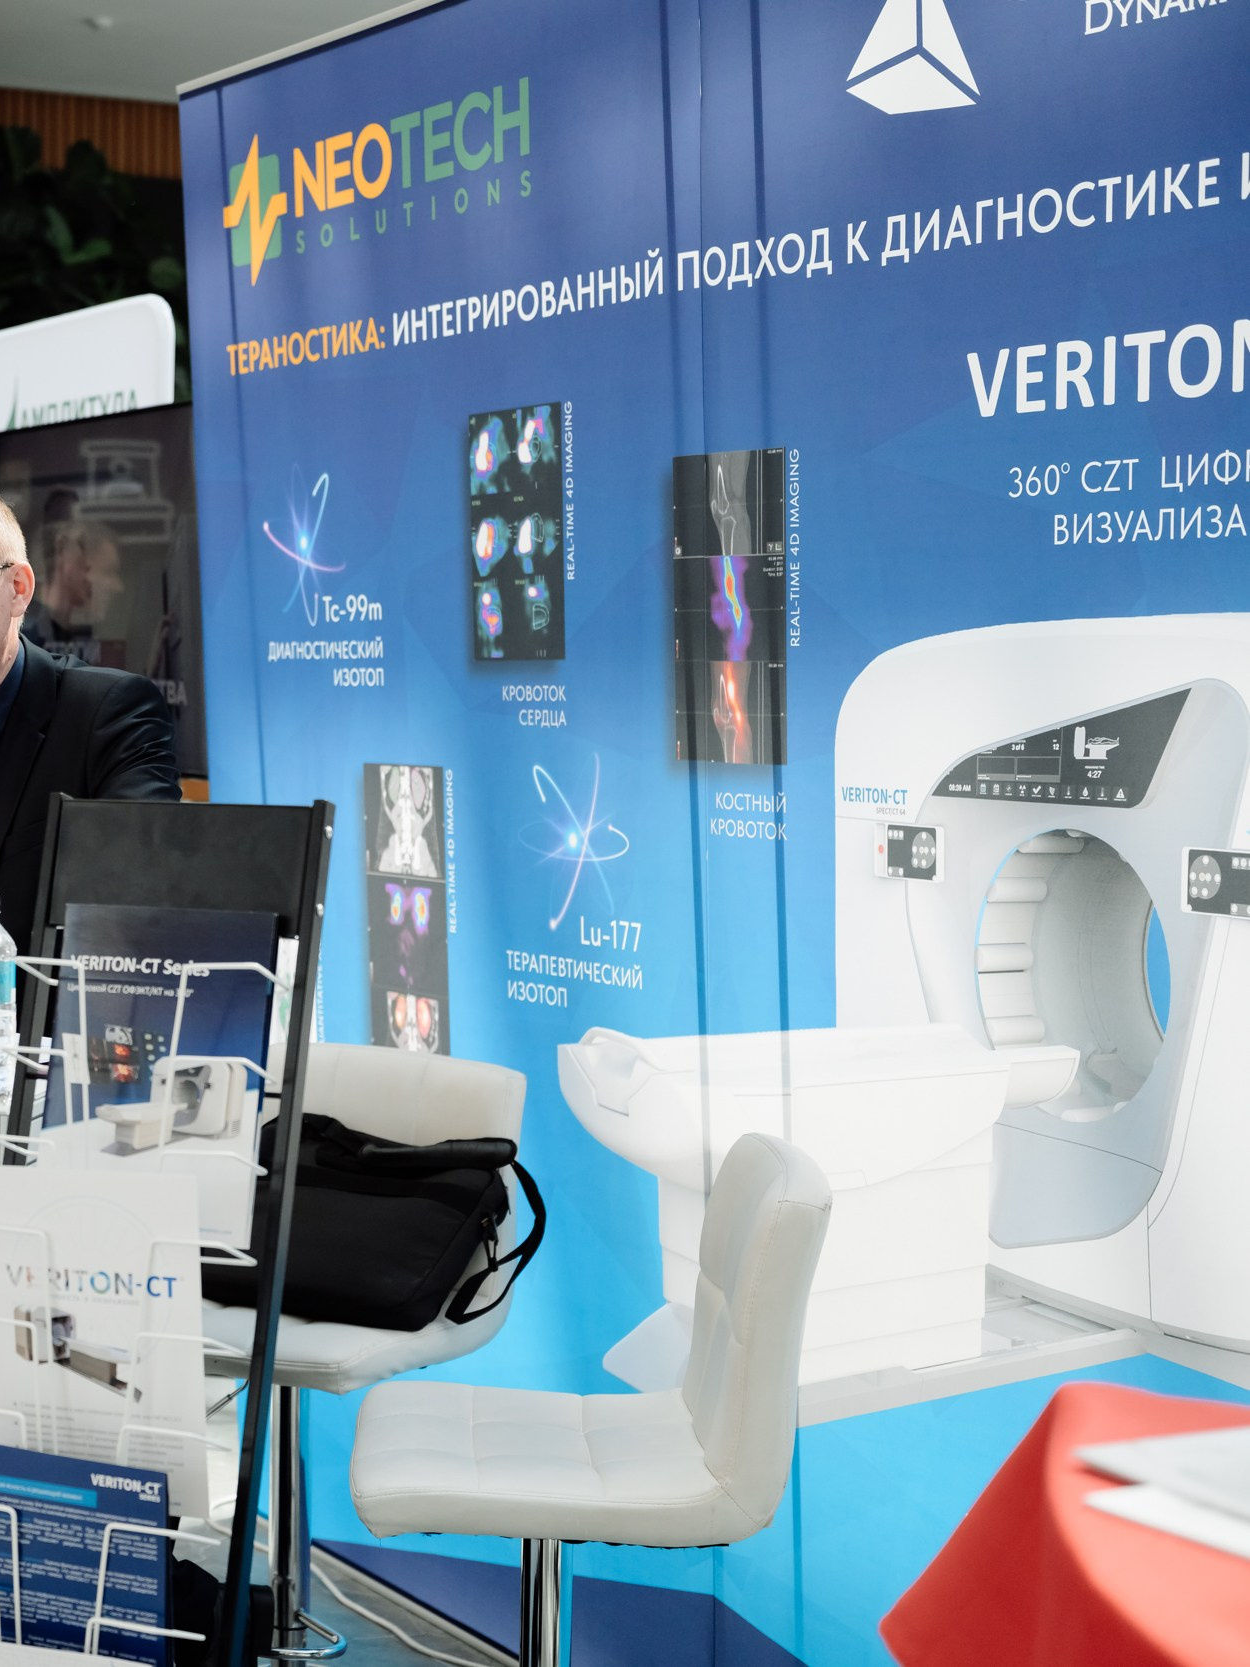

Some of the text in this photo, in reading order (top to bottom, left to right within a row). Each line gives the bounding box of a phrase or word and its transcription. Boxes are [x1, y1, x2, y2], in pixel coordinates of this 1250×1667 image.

[293, 77, 530, 217] NEOTECH
[296, 170, 532, 255] SOLUTIONS
[226, 317, 385, 376] ТЕРАНОСТИКА:
[392, 248, 665, 346] ИНТЕГРИРОВАННЫЙ
[677, 228, 832, 292] ПОДХОД
[847, 221, 870, 264] К
[881, 158, 1221, 266] ДИАГНОСТИКЕ
[564, 401, 576, 580] REAL-TIME 4D IMAGING
[1081, 459, 1139, 493] CZT
[1053, 503, 1248, 546] ВИЗУАЛИЗА
[789, 448, 800, 647] REAL-TIME 4D IMAGING
[322, 594, 383, 623] Tc-99m
[268, 636, 384, 662] ДИАГНОСТИЧЕСКИЙ
[333, 668, 385, 687] ИЗОТОП
[502, 685, 567, 702] КРОВОТОК
[519, 710, 567, 728] СЕРДЦА
[715, 792, 787, 813] КОСТНЫЙ
[841, 786, 908, 805] VERITON-CT
[710, 818, 787, 840] КРОВОТОК
[445, 769, 457, 933] REAL-TIME 4D IMAGING
[580, 915, 642, 952] Lu-177
[70, 954, 162, 974] VERITON-CT
[506, 949, 643, 990] ТЕРАПЕВТИЧЕСКИЙ
[507, 980, 568, 1008] ИЗОТОП
[90, 1472, 162, 1496] VERITON-CT
